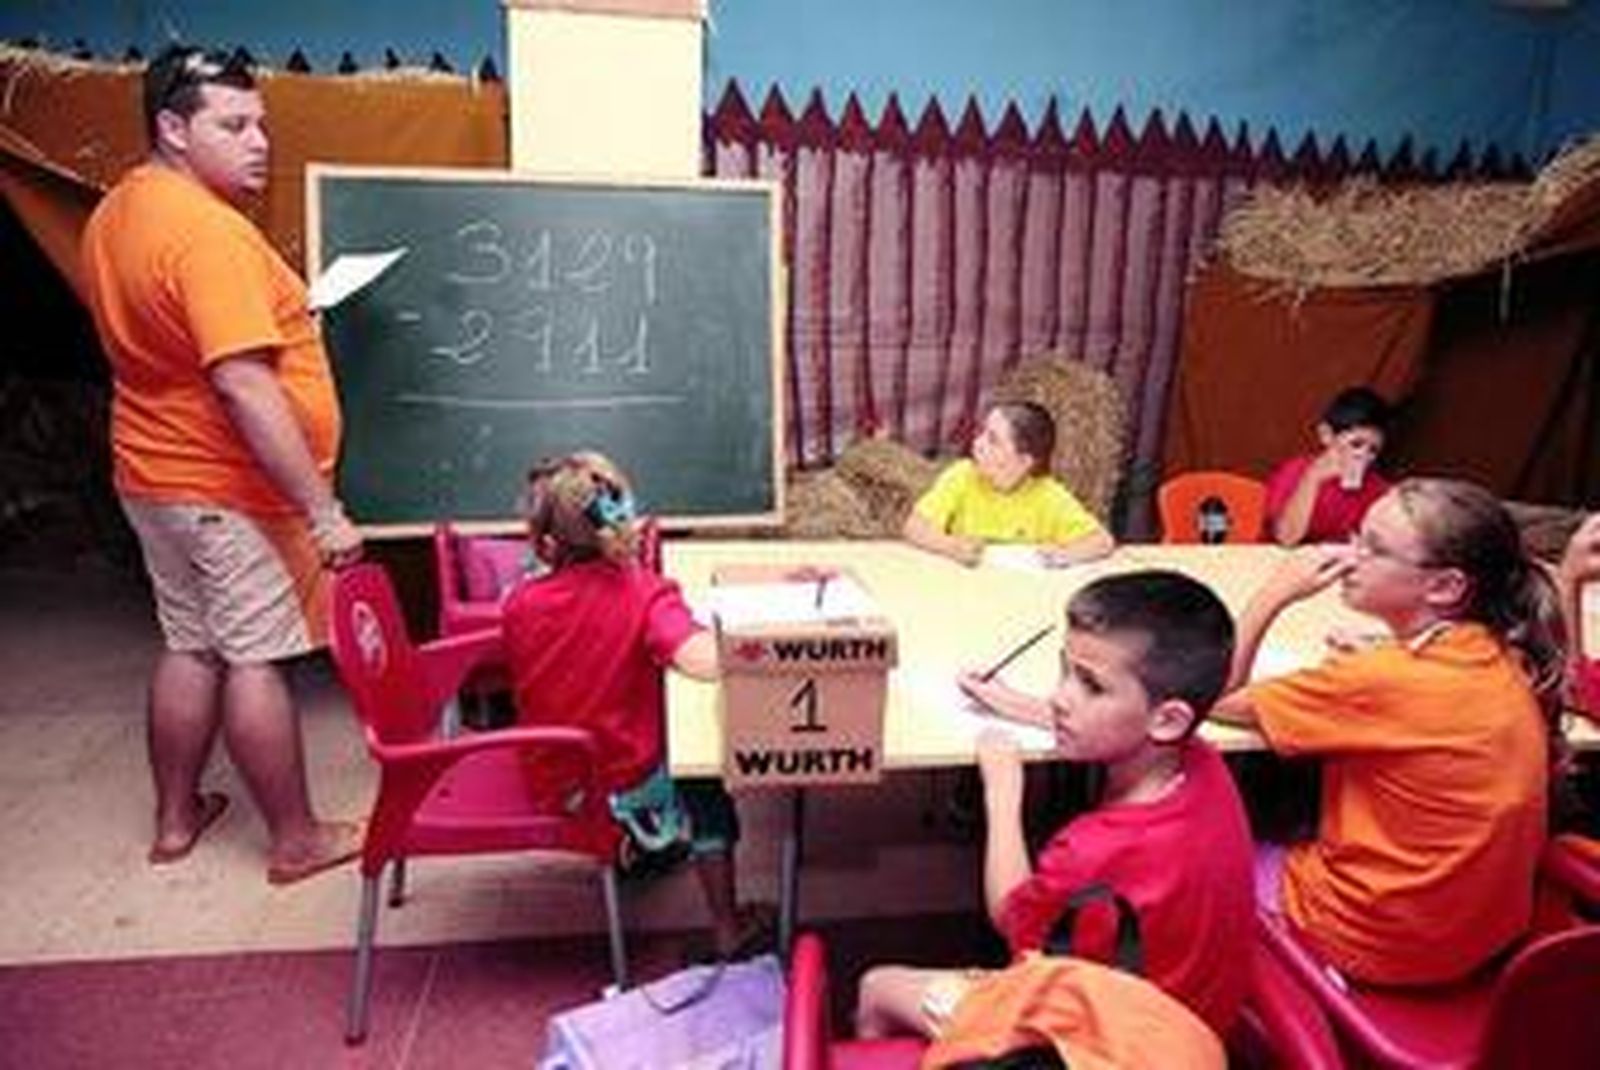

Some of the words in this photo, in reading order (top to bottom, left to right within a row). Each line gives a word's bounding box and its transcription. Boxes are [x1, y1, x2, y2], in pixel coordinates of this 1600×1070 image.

[447, 221, 656, 305] 3129
[773, 638, 887, 661] WURTH
[790, 678, 828, 732] 1
[735, 747, 873, 775] WURTH
